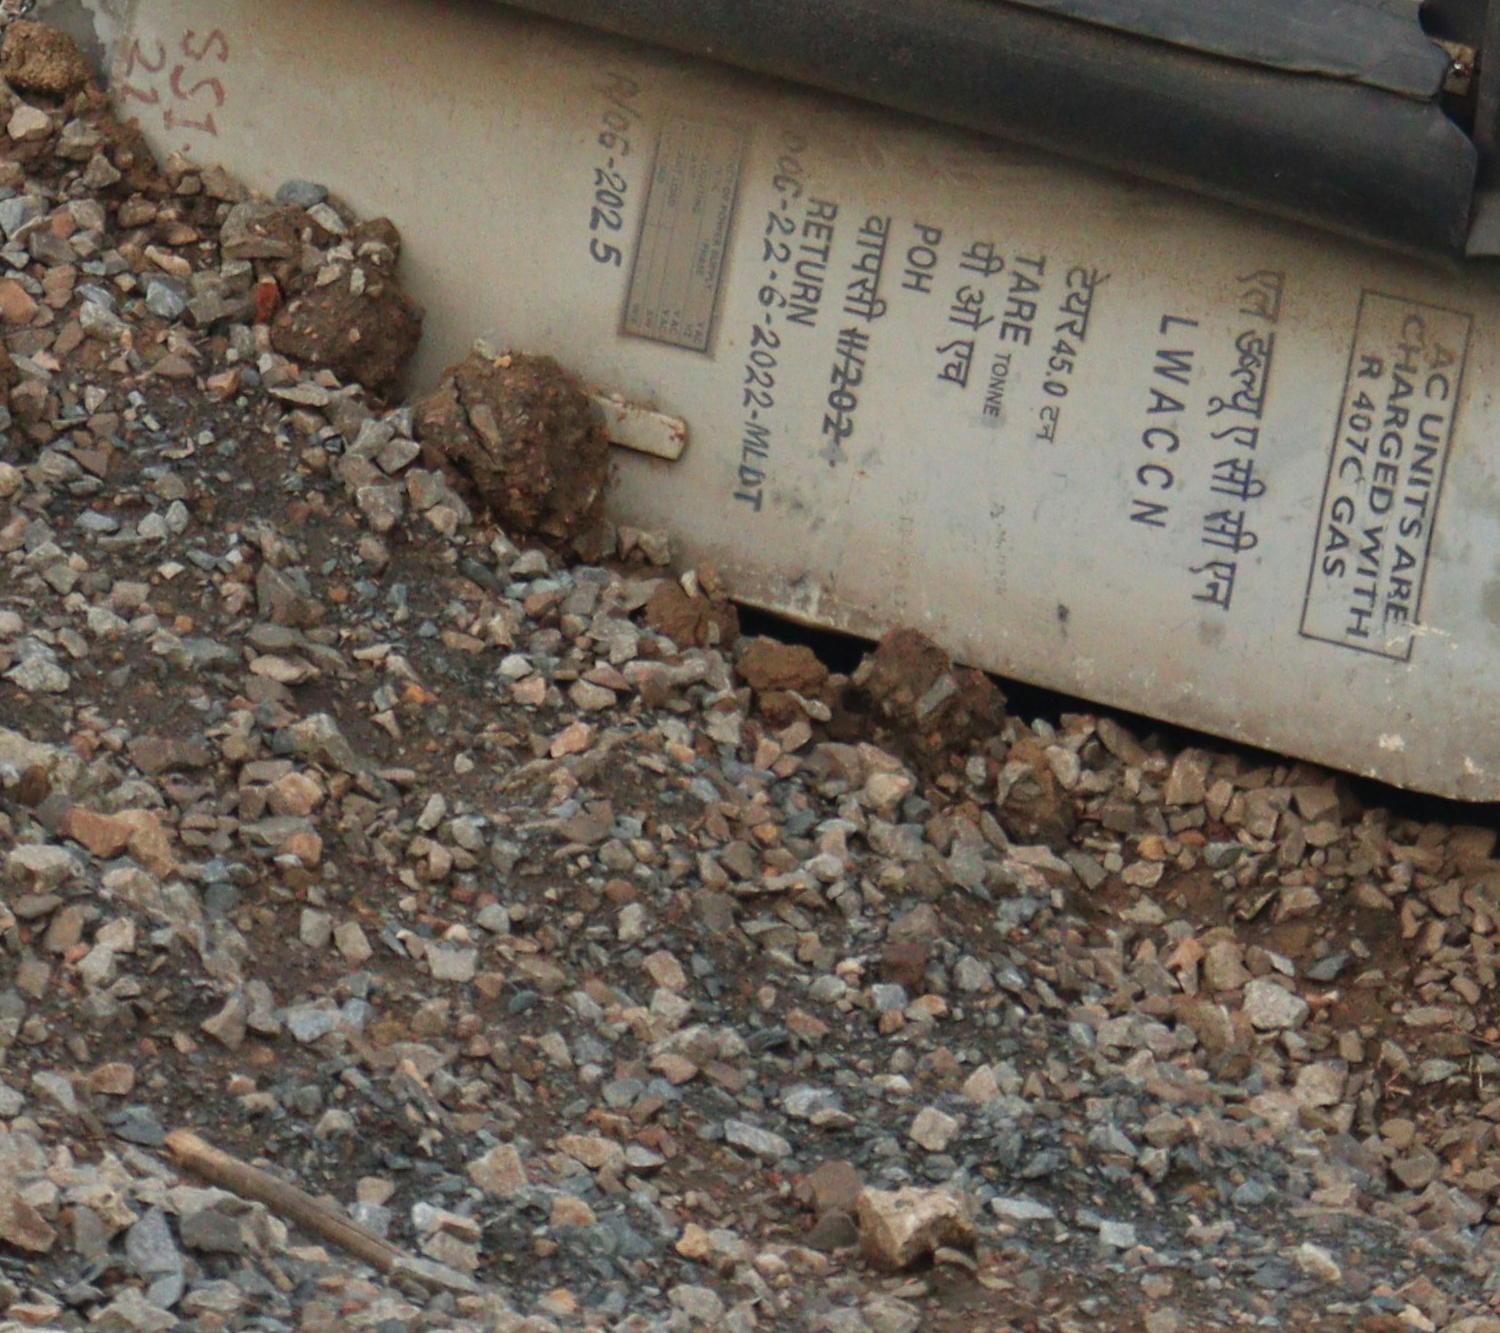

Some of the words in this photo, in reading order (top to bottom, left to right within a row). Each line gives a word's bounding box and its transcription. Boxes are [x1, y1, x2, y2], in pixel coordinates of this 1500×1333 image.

[712, 204, 727, 246] POWER
[785, 201, 838, 328] RETURN
[843, 215, 892, 323] वापसी
[901, 222, 943, 295] POH
[959, 241, 1005, 278] पी
[948, 284, 995, 332] ओ
[999, 256, 1046, 347] TARE
[1236, 268, 1287, 325] एल
[935, 339, 976, 390] एच
[982, 353, 1012, 421] TONNE
[1041, 338, 1077, 398] 45.0
[1357, 354, 1384, 379] R
[1424, 342, 1455, 401] AC
[1034, 405, 1061, 445] टन
[1209, 425, 1260, 451] ए
[1338, 391, 1376, 484] 407C
[1368, 315, 1425, 516] CHARGED
[1209, 457, 1268, 502] सी
[1398, 413, 1444, 538] UNITS
[1201, 509, 1259, 554] सी
[1321, 495, 1355, 578] GAS
[1188, 559, 1238, 612] एन
[1345, 525, 1384, 639] WITH
[1383, 544, 1417, 623] ARE
